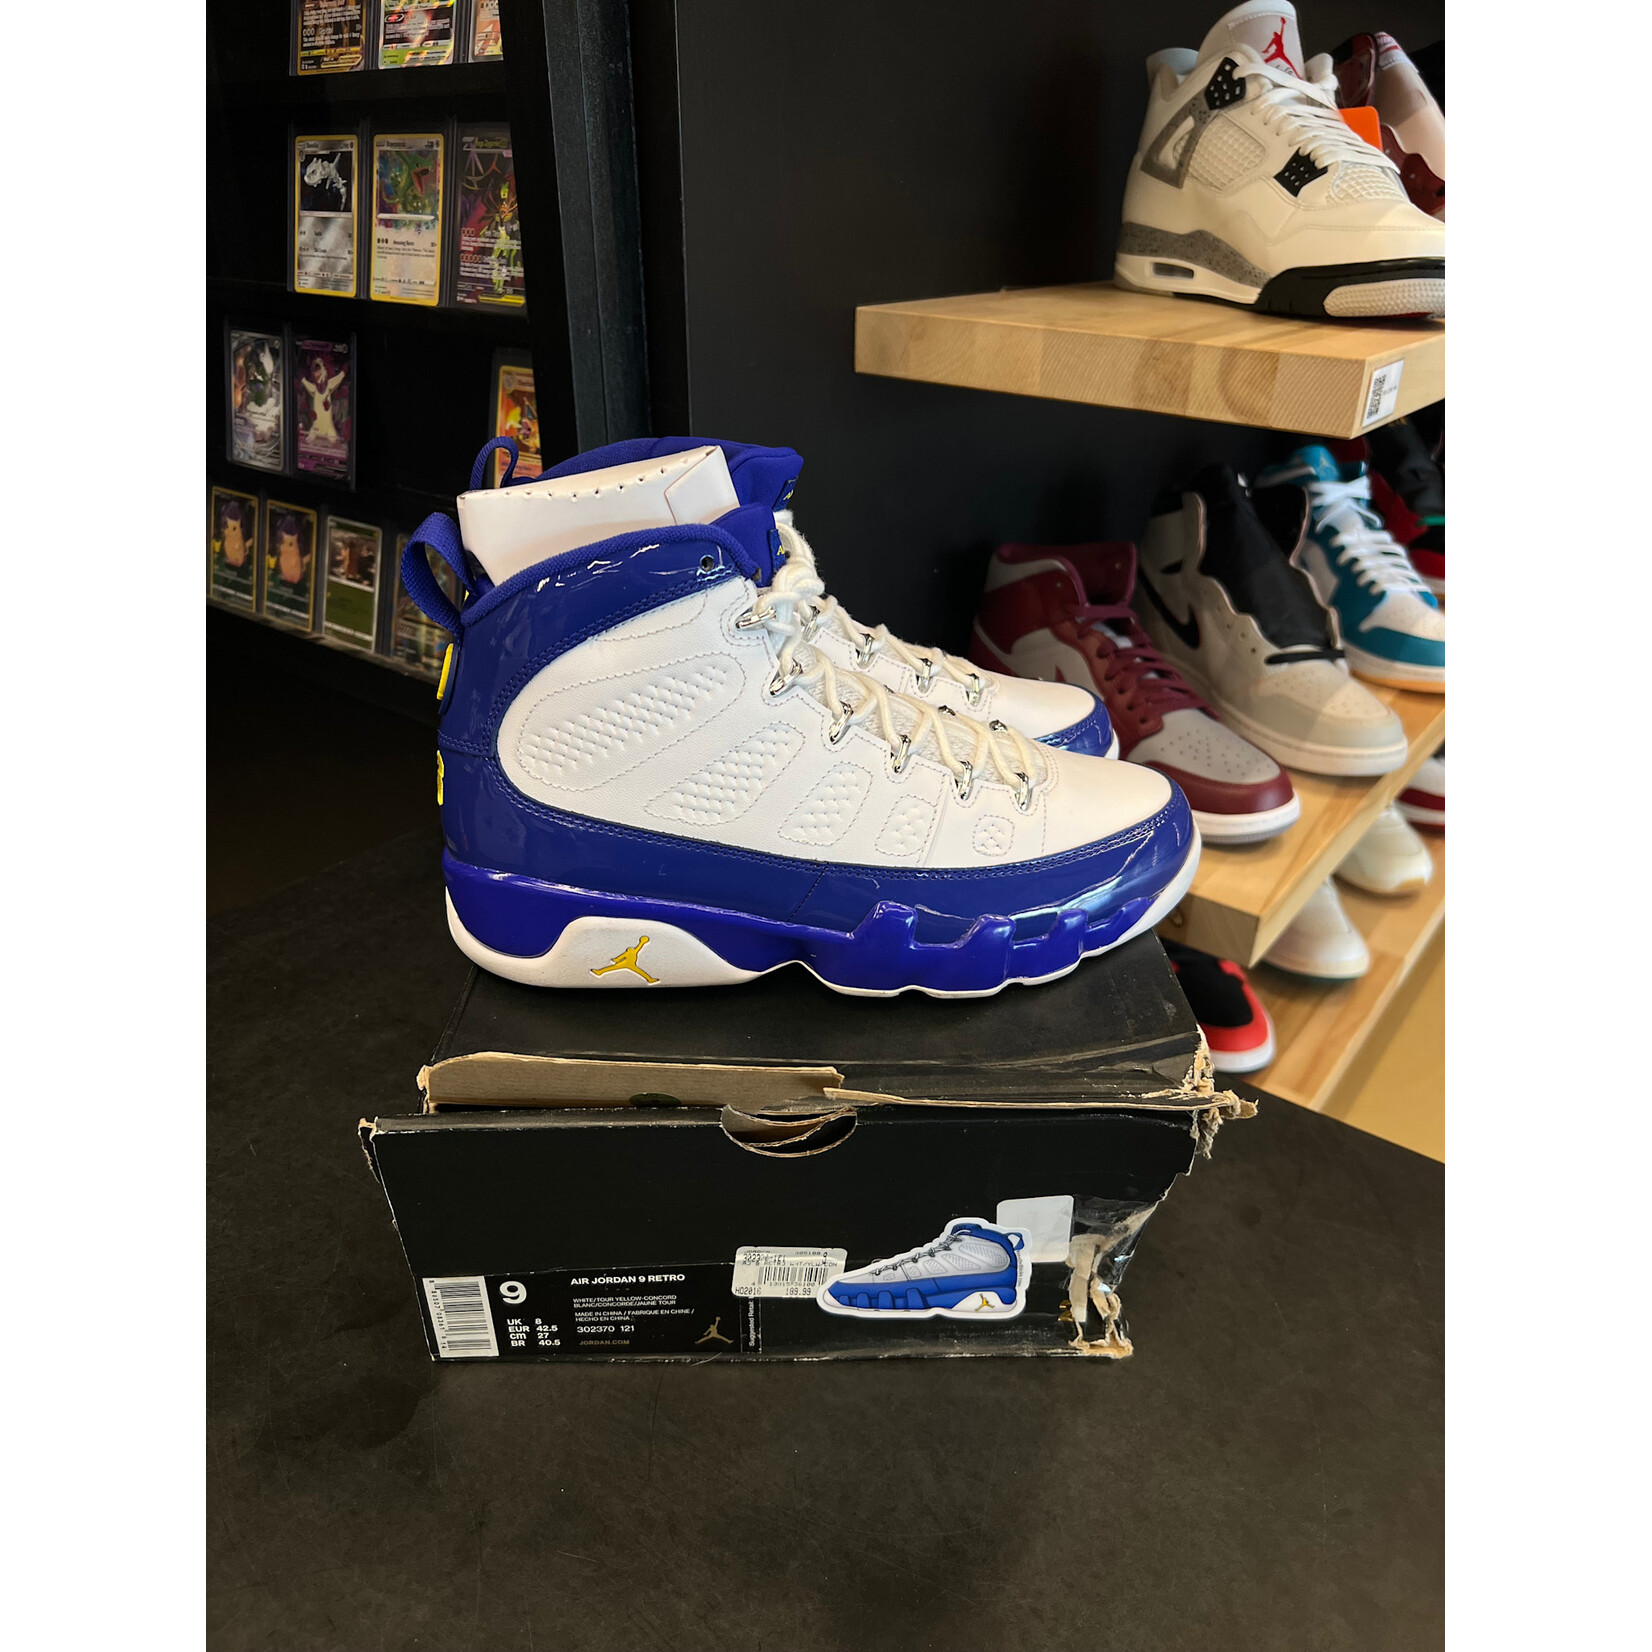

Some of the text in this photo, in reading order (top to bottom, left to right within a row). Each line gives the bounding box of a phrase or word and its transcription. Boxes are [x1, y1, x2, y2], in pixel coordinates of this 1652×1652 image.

[591, 1276, 636, 1284] JORDAN
[638, 1275, 646, 1283] 9
[648, 1274, 685, 1282] RETRO
[500, 1280, 527, 1304] 9
